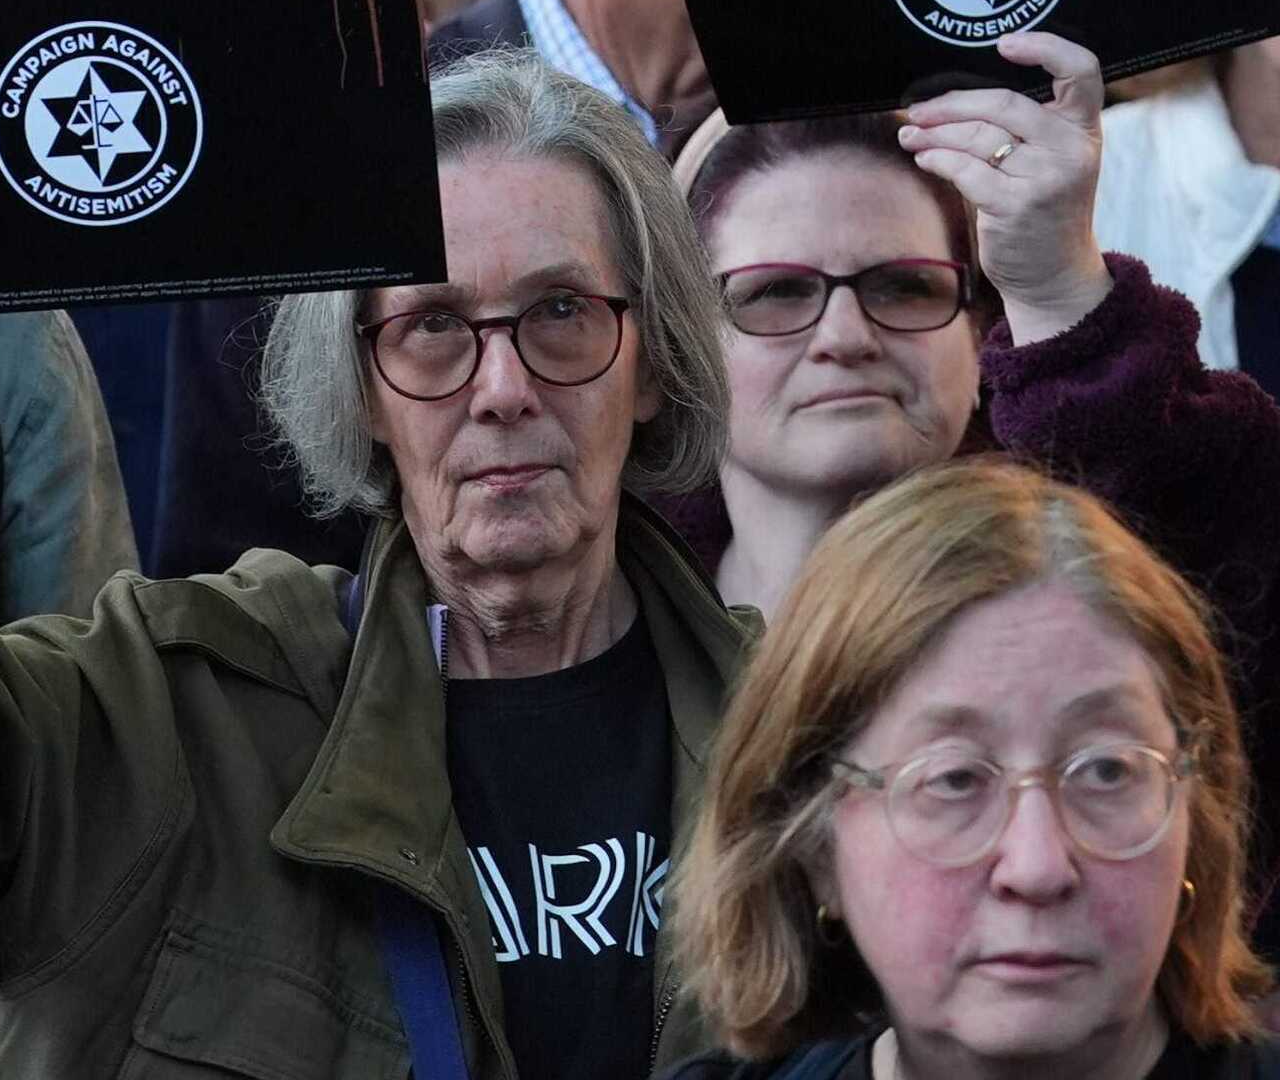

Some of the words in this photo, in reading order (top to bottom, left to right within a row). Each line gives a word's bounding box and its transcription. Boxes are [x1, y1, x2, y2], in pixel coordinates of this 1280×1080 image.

[1, 33, 95, 118] CAMPAIGN
[102, 35, 187, 107] AGAINST
[24, 163, 178, 214] ANTISEMITISM
